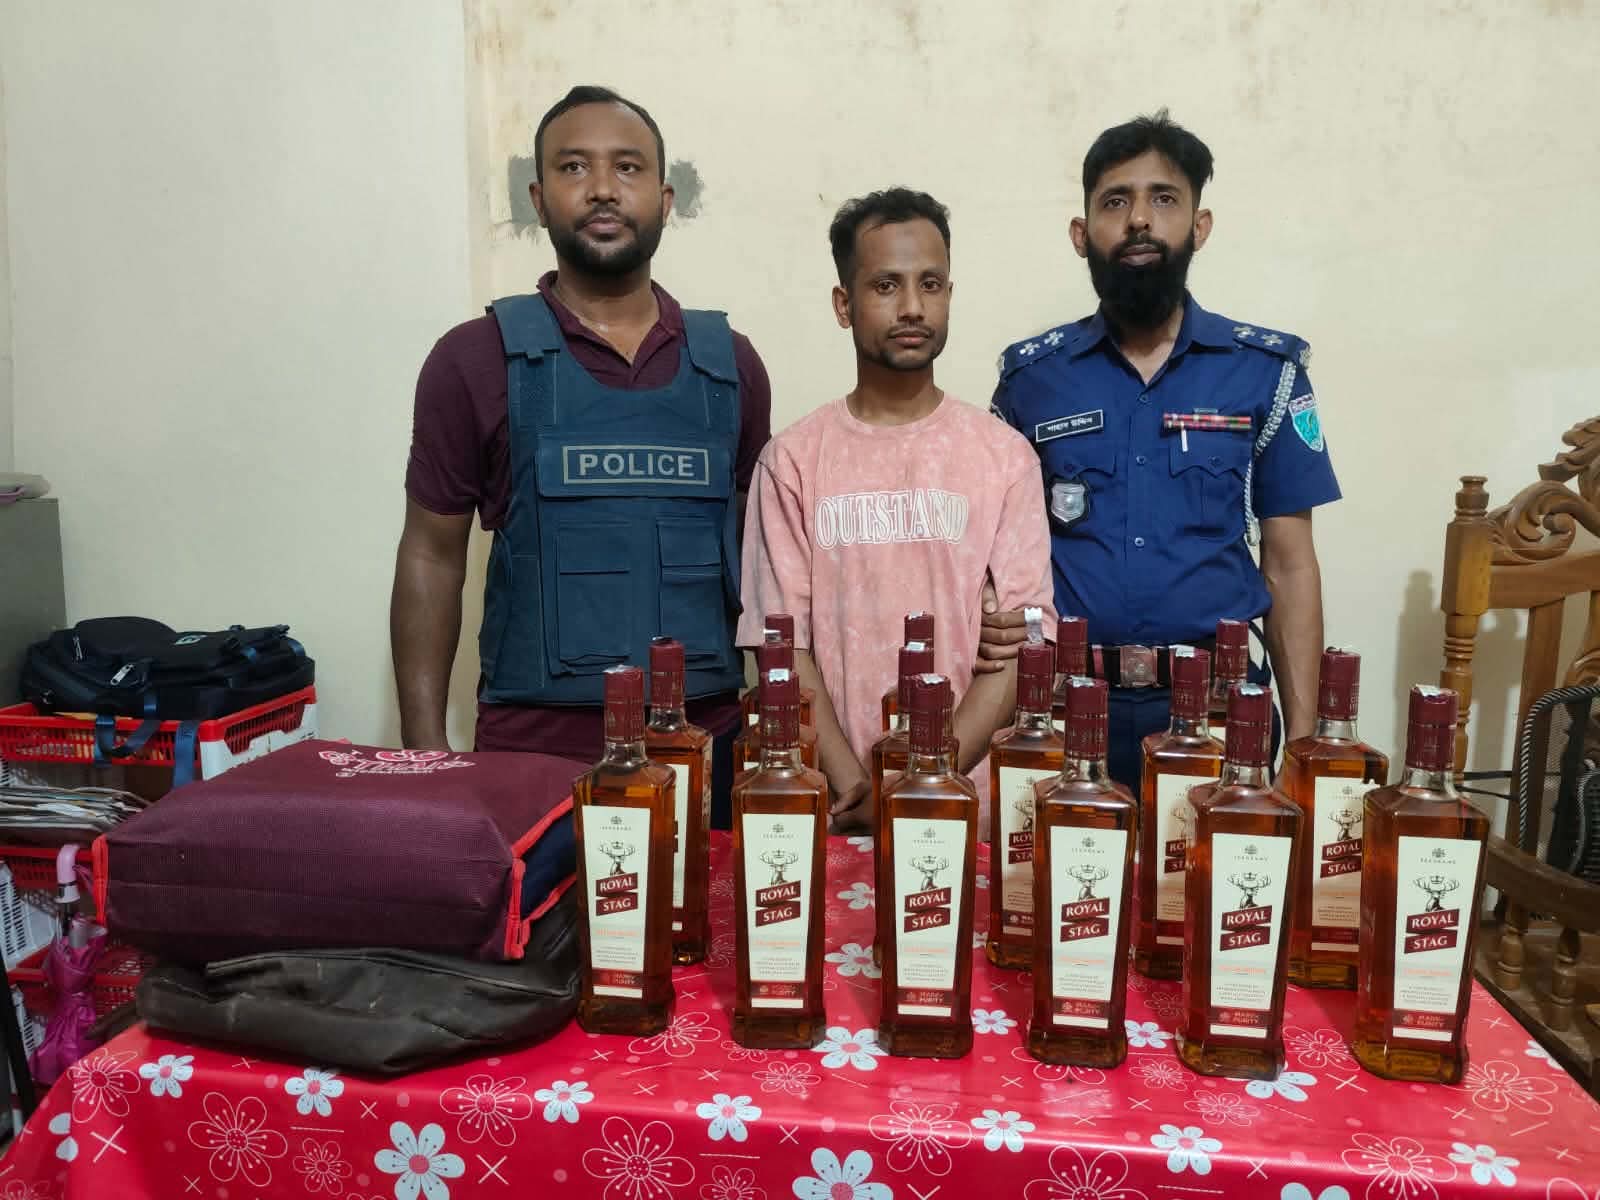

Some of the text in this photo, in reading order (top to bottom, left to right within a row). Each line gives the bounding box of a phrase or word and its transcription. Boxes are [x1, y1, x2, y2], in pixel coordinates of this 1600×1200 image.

[578, 452, 695, 477] POLICE
[815, 487, 969, 551] OUTSTAND
[1326, 840, 1360, 857] ROYAL
[1327, 861, 1356, 875] STAG
[599, 876, 635, 892] ROYAL
[760, 885, 797, 903] ROYAL
[909, 891, 946, 909] ROYAL
[602, 898, 632, 912] STAG
[1066, 901, 1105, 918] ROYAL
[763, 907, 793, 922] STAG
[912, 913, 943, 928] STAG
[1226, 909, 1268, 926] ROYAL
[1411, 913, 1454, 930] ROYAL
[1068, 923, 1101, 938] STAG
[1228, 931, 1262, 947] STAG
[1413, 935, 1448, 950] STAG
